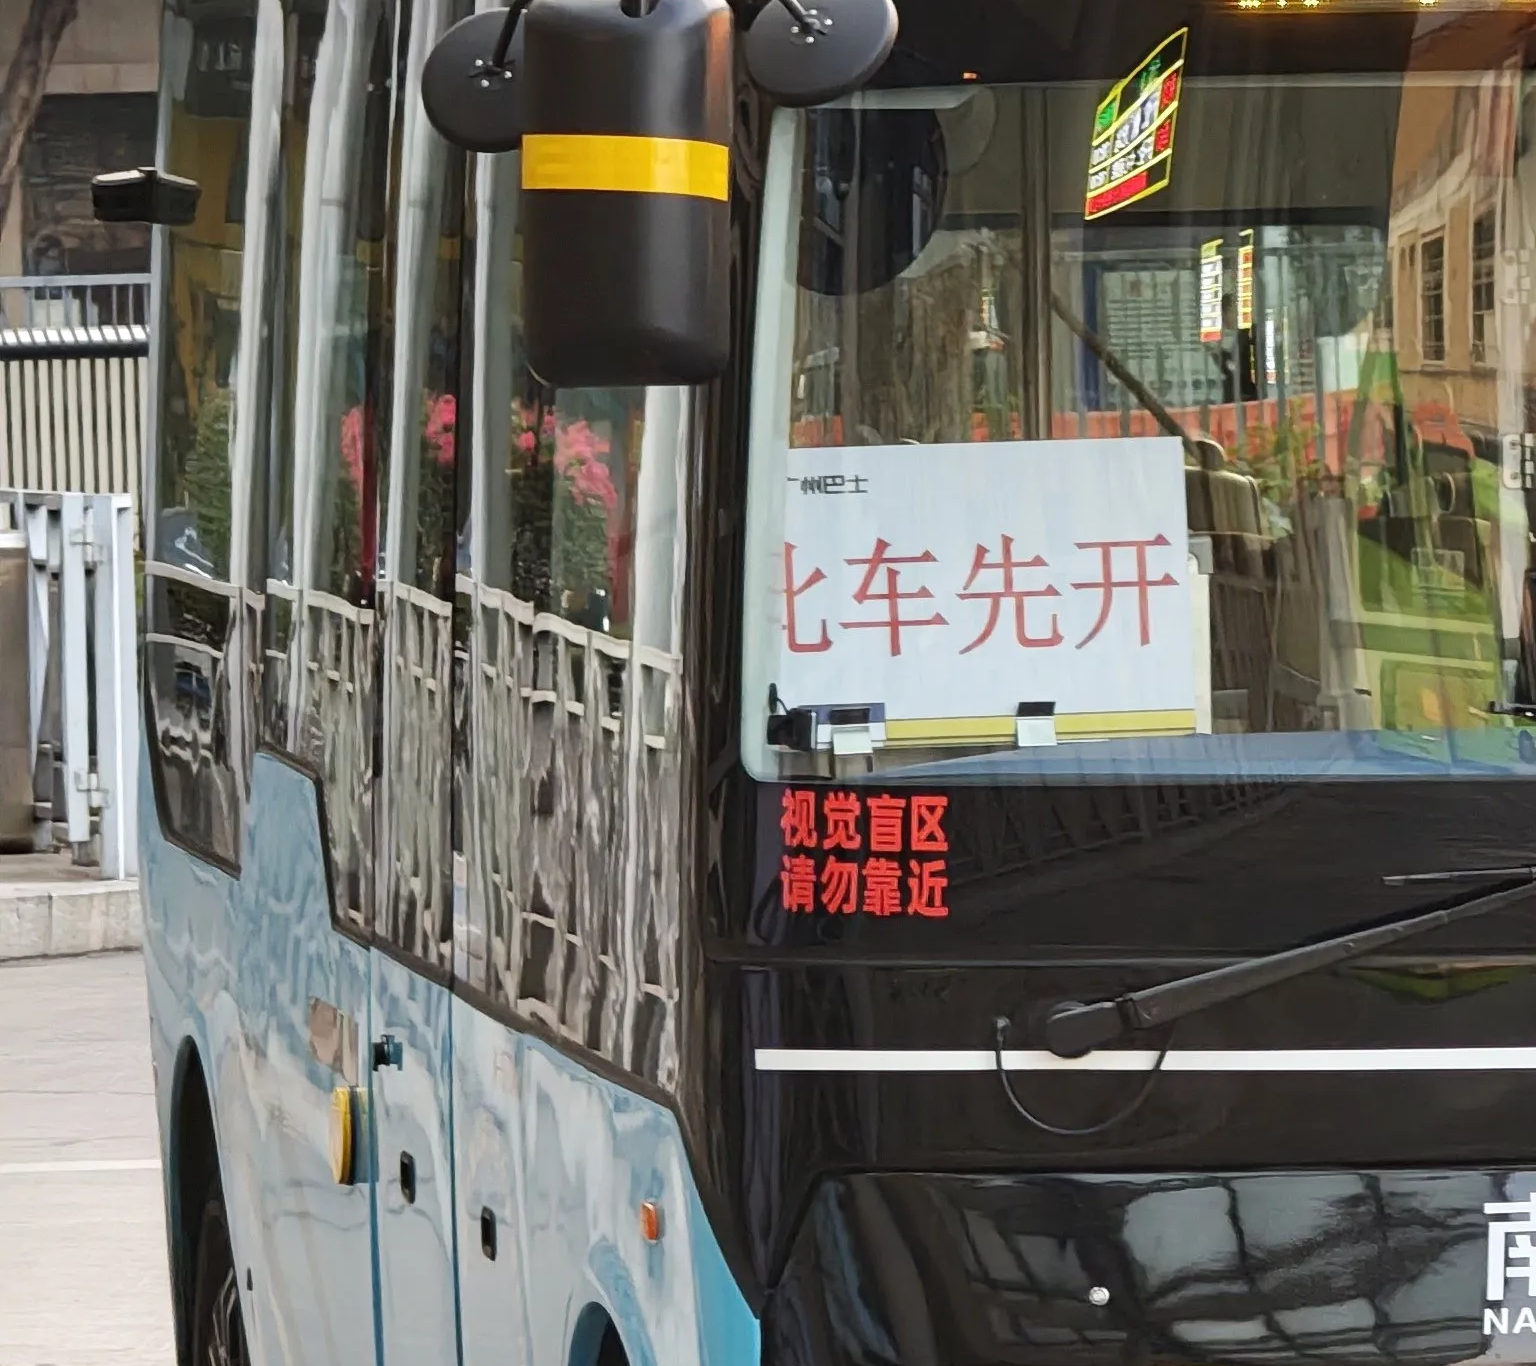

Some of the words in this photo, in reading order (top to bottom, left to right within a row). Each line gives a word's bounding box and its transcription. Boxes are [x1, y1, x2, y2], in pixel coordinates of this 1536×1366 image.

[786, 474, 869, 495] 州巴士
[780, 788, 949, 852] 视觉盲区
[780, 854, 949, 918] 请勿靠近
